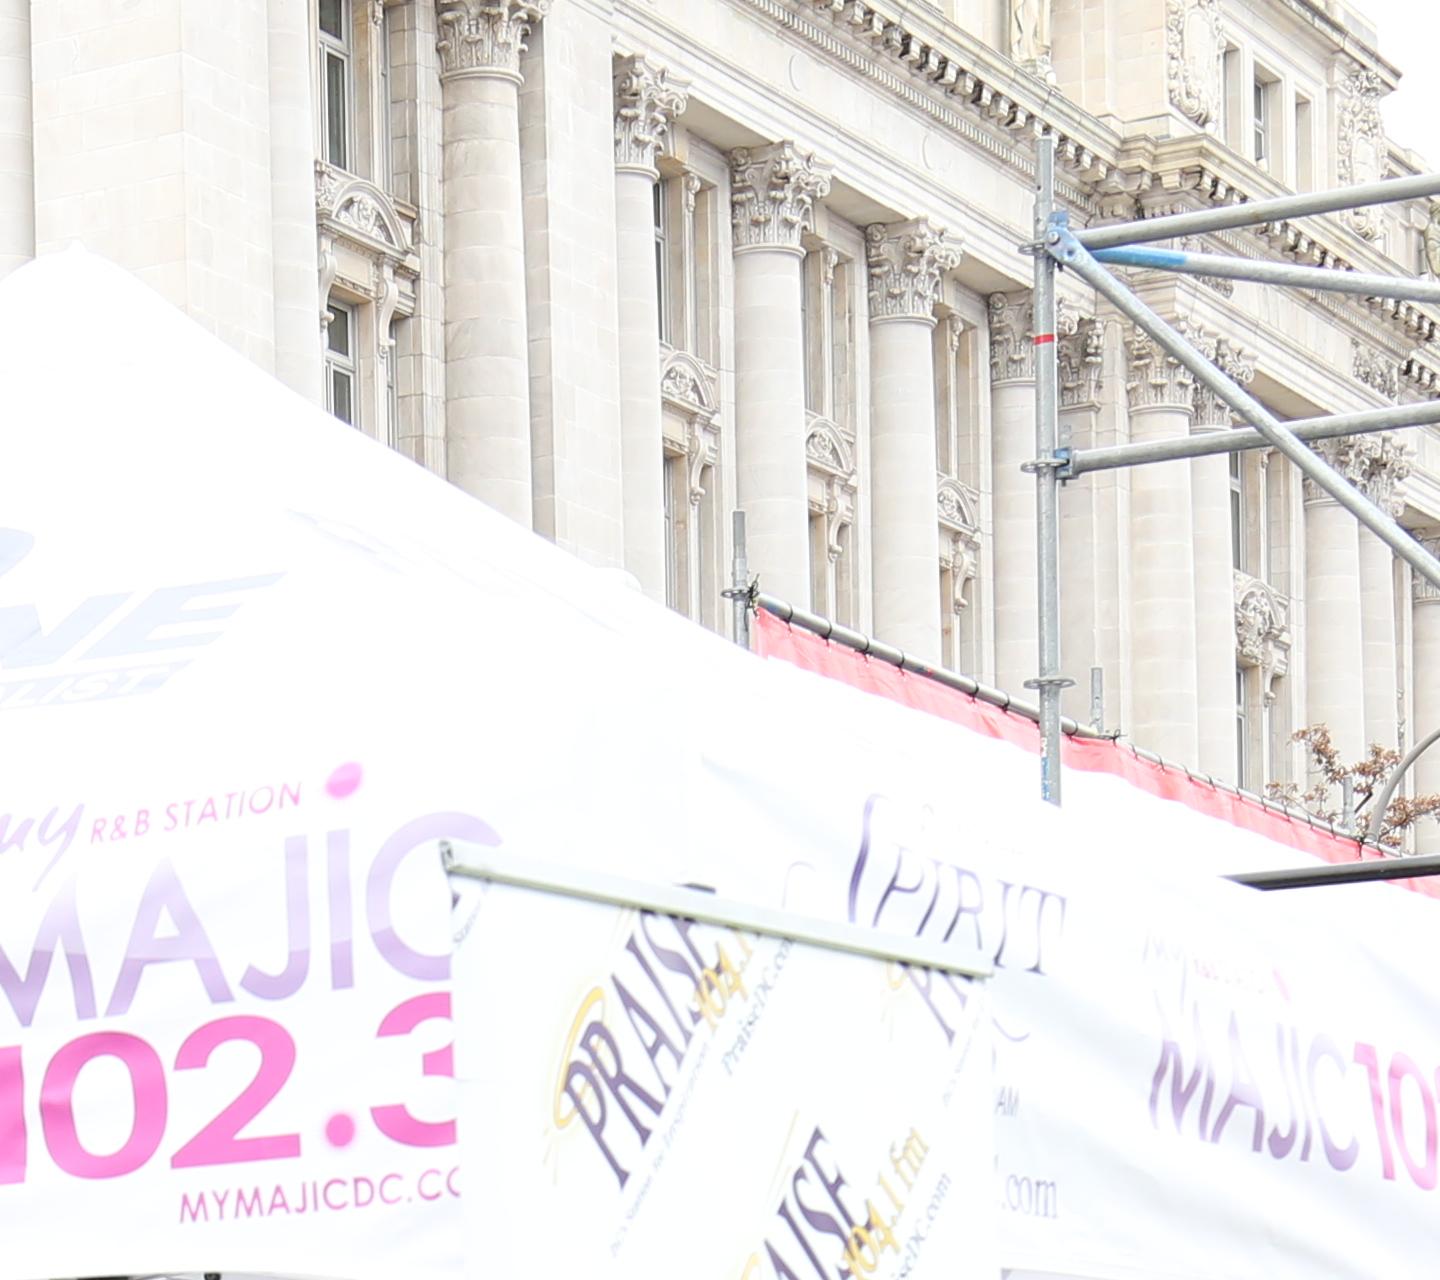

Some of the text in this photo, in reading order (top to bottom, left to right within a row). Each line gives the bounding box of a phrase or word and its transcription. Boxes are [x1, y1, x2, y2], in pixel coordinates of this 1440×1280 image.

[89, 808, 152, 845] R&B
[163, 780, 303, 832] STATION
[892, 1129, 929, 1188] fm
